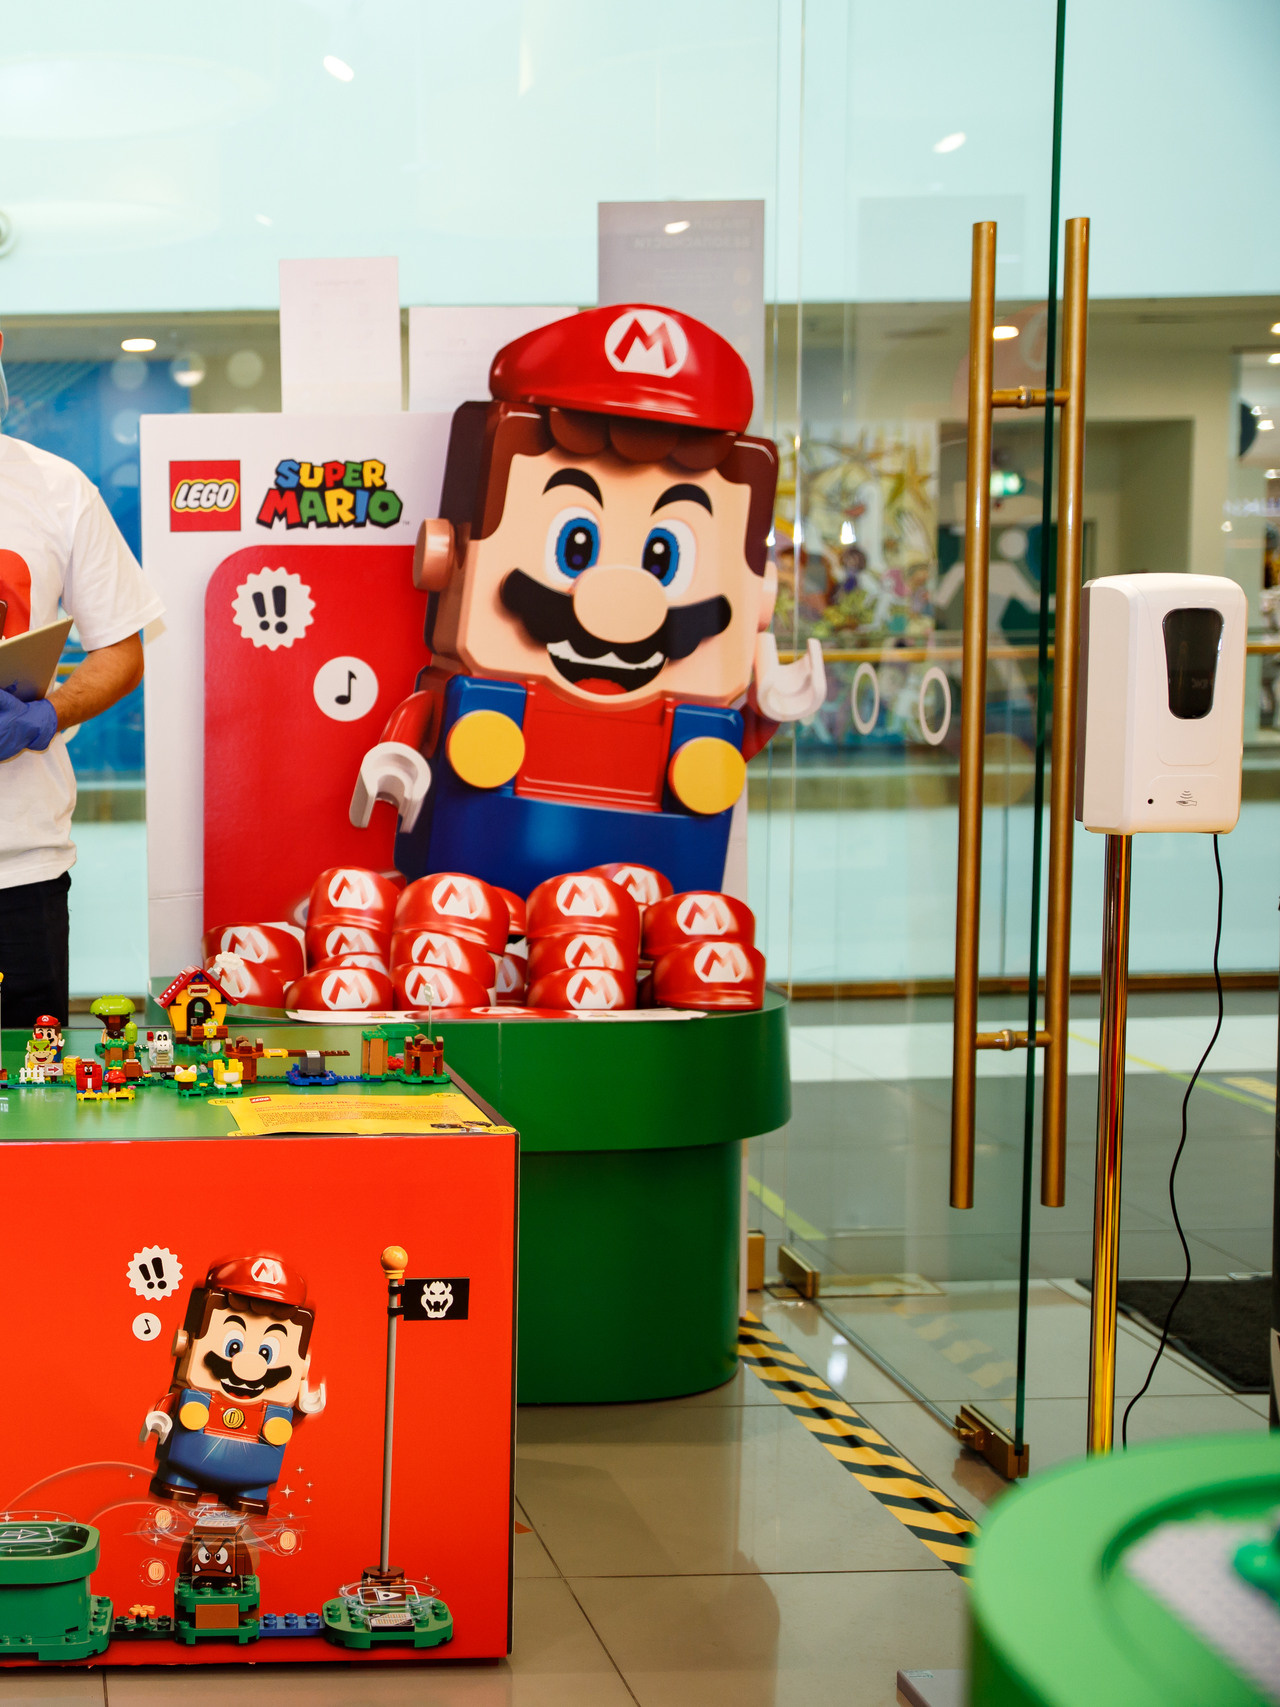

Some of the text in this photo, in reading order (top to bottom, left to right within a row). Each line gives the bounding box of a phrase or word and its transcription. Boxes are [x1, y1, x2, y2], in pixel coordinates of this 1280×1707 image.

[274, 459, 387, 489] SUPER
[172, 479, 239, 512] LEGO
[256, 487, 403, 530] MARIO
